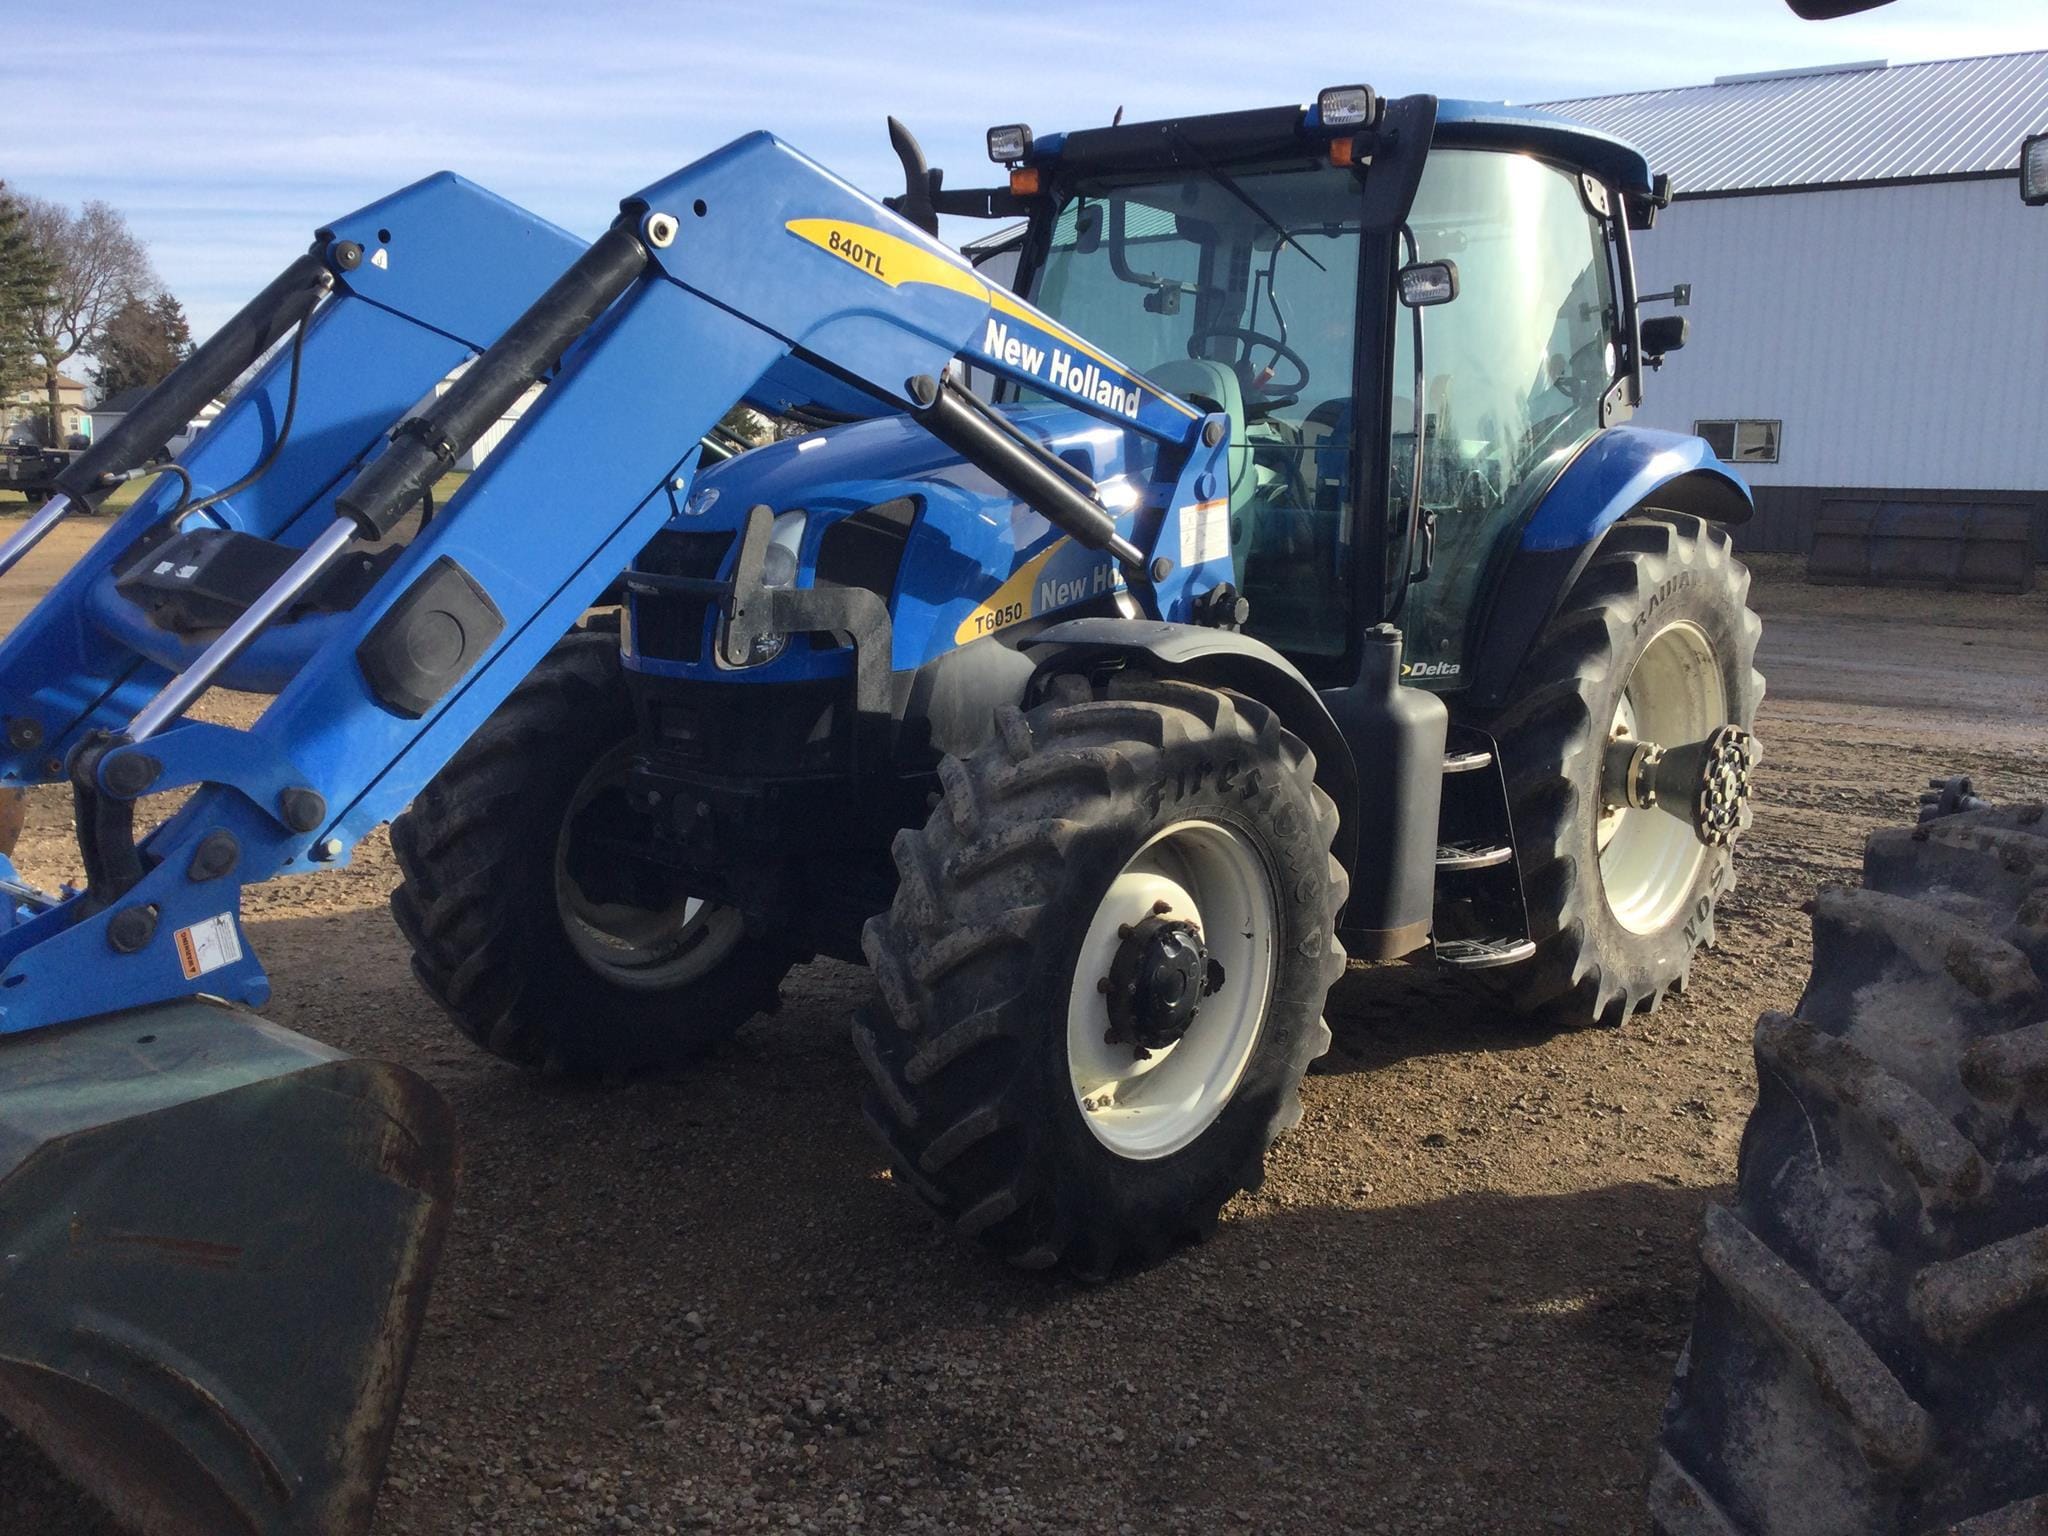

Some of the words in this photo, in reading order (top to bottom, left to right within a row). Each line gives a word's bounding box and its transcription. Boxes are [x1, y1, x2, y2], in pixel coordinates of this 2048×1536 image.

[828, 231, 886, 277] 840TL
[983, 318, 1045, 375] New
[1049, 349, 1141, 420] Holland
[1040, 575, 1088, 611] New
[975, 602, 1023, 635] T6050
[1410, 661, 1461, 677] Delta
